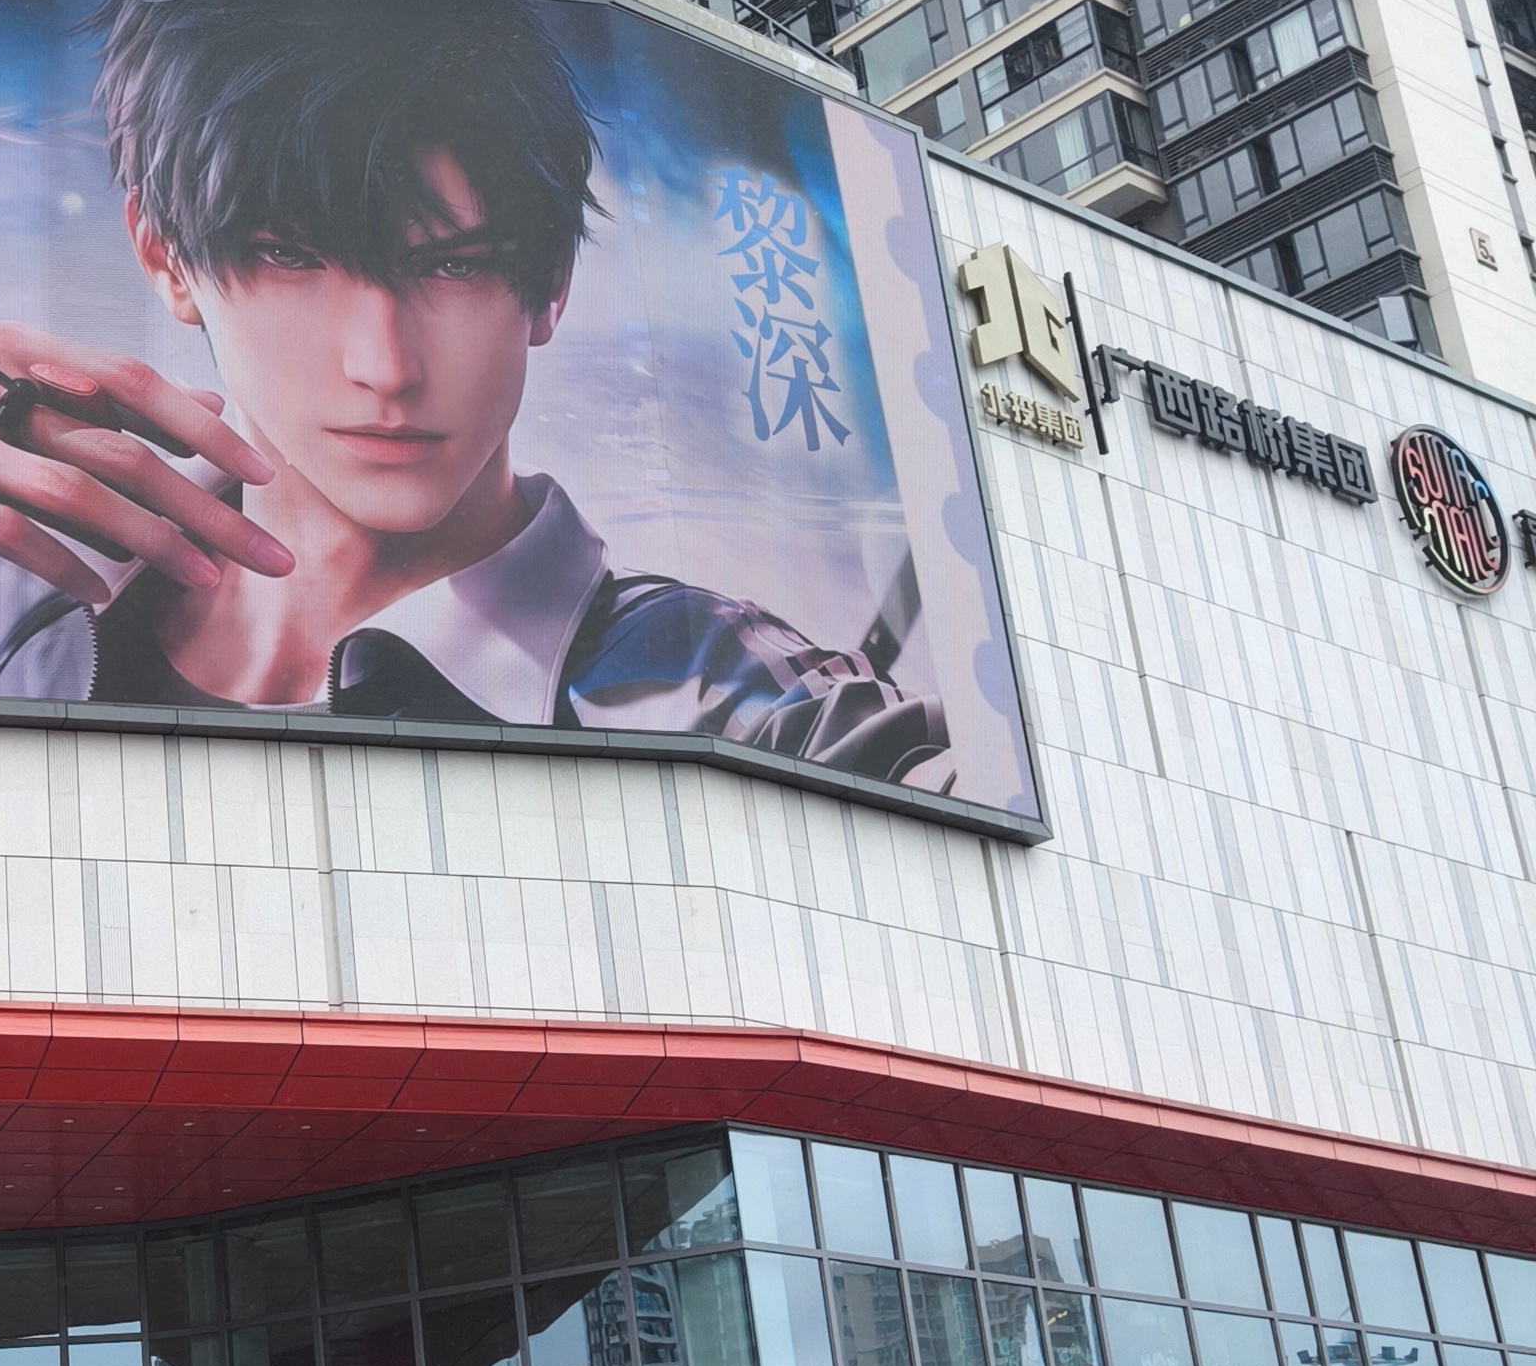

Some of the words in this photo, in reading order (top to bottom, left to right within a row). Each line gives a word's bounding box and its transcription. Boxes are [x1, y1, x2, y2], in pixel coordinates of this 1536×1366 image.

[707, 166, 852, 451] 黎深
[981, 383, 1087, 449] 北投集团
[1094, 343, 1379, 504] 广西路桥集团
